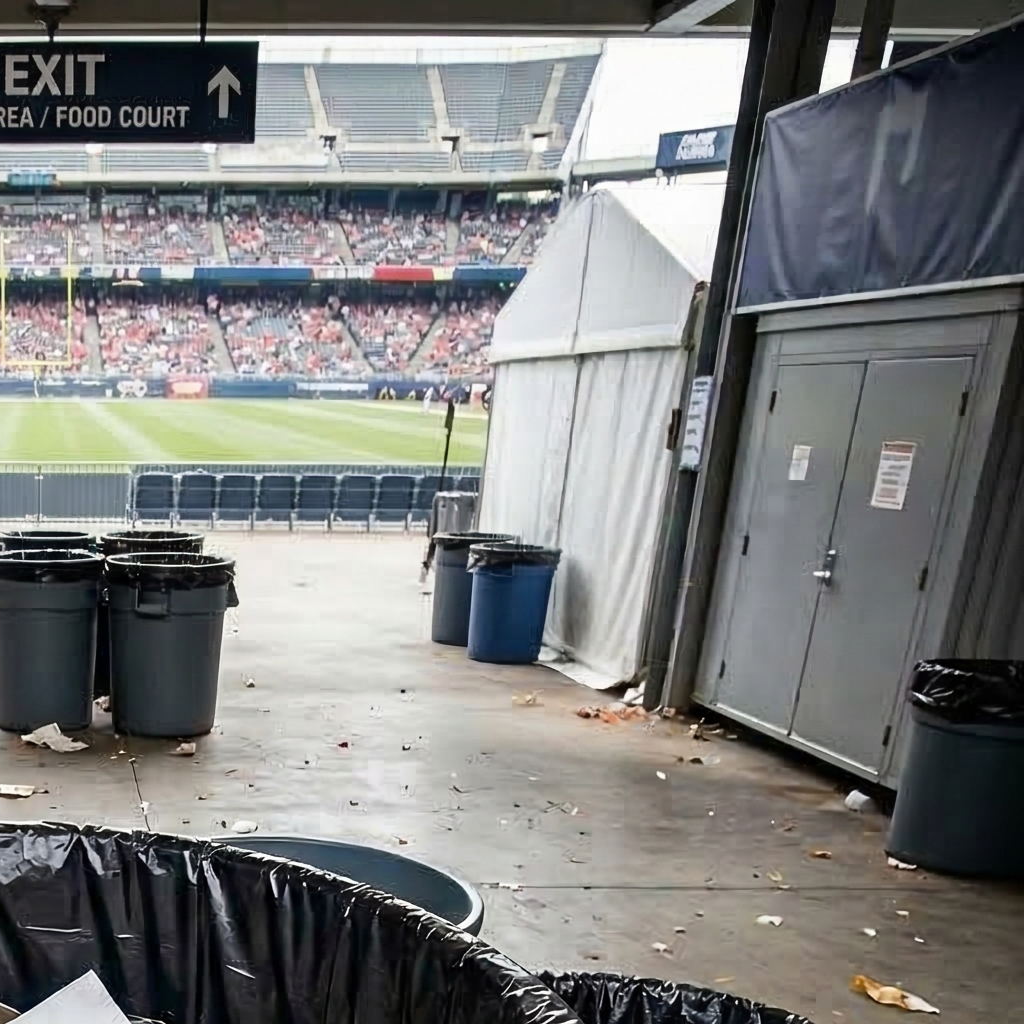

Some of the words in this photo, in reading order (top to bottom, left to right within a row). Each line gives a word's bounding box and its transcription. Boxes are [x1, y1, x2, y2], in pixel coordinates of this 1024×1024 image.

[4, 54, 105, 96] EXIT
[39, 106, 49, 128] /
[55, 106, 112, 128] FOOD
[119, 106, 190, 128] COURT
